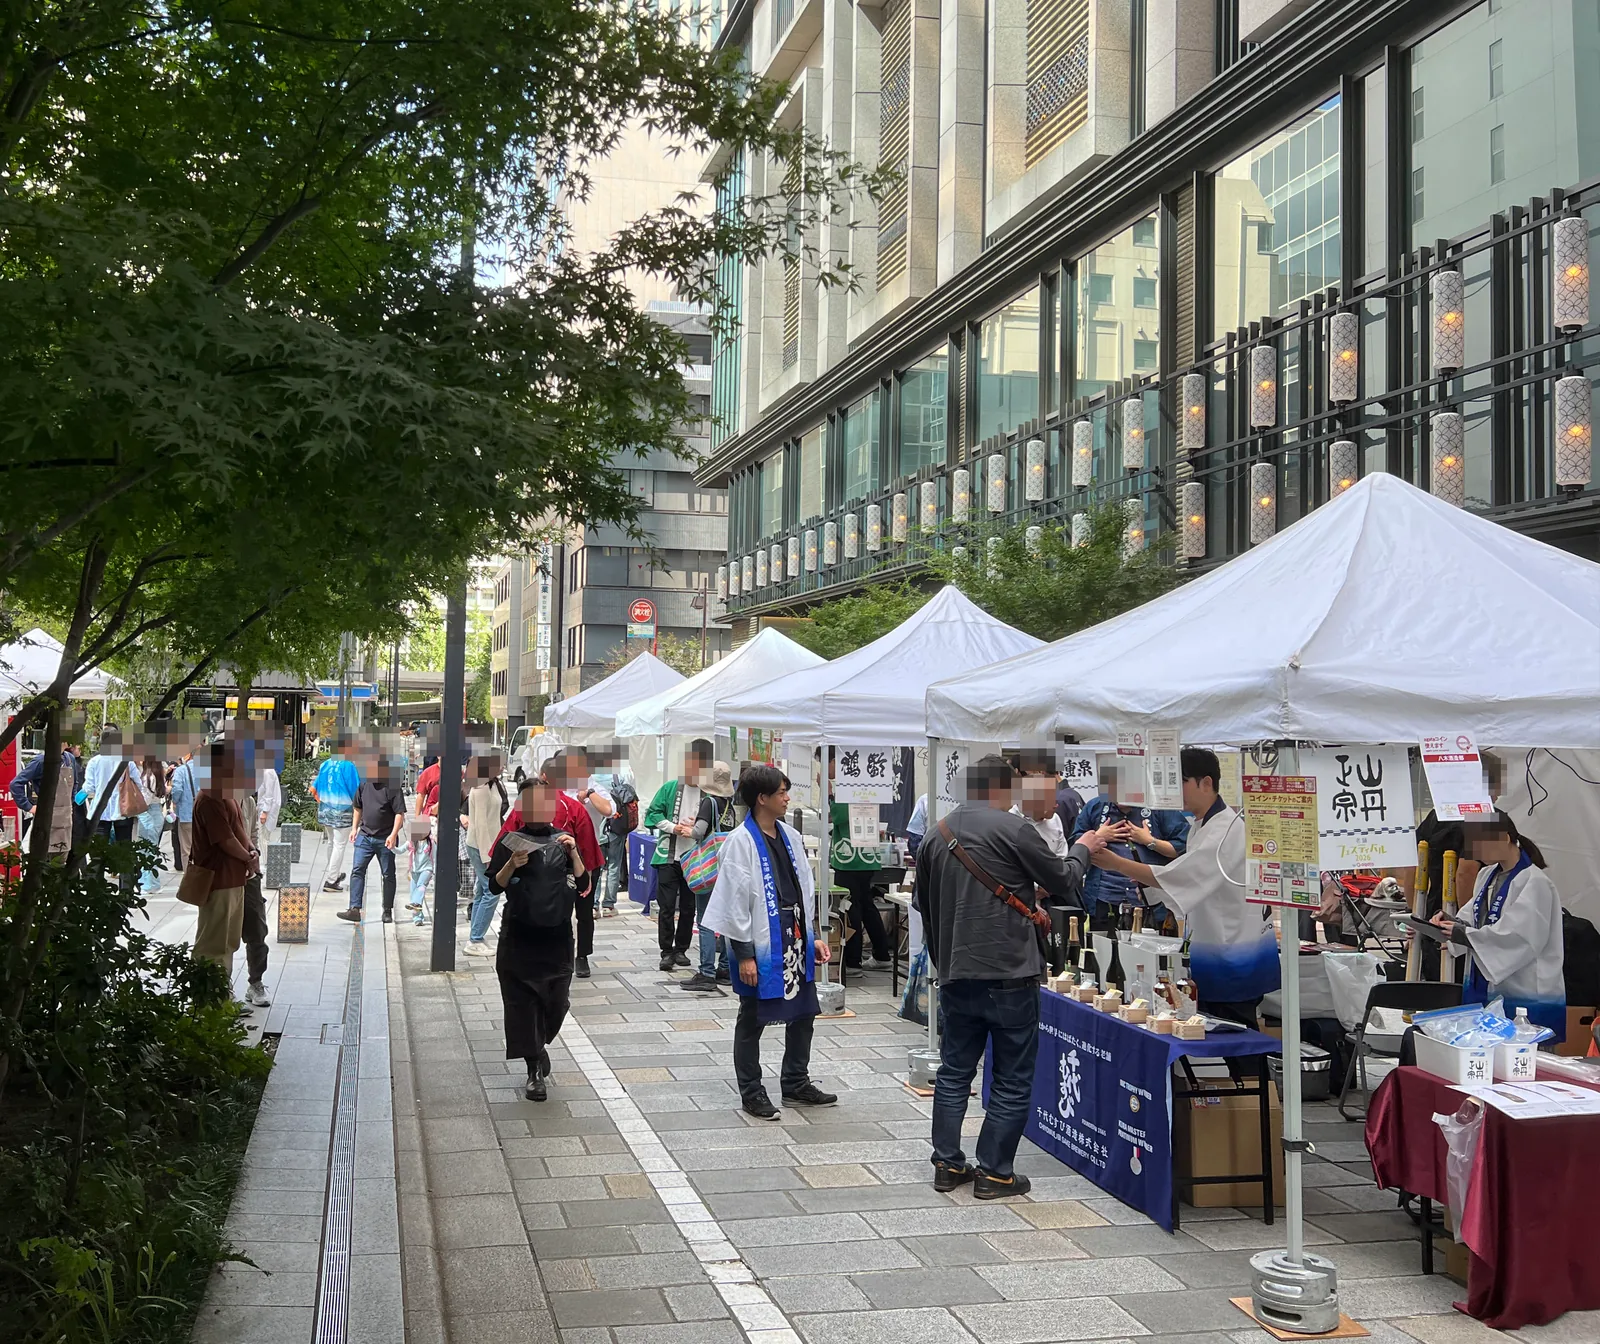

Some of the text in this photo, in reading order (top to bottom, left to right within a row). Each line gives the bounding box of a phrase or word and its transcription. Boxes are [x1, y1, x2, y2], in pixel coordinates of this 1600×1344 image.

[541, 545, 549, 594] 扶桑工業
[634, 607, 651, 617] 消火栓
[1249, 795, 1313, 804] コイン・チケットのご案内
[1336, 843, 1388, 858] フェスティバル
[1036, 1106, 1109, 1158] 千代むすび酒造株式会社
